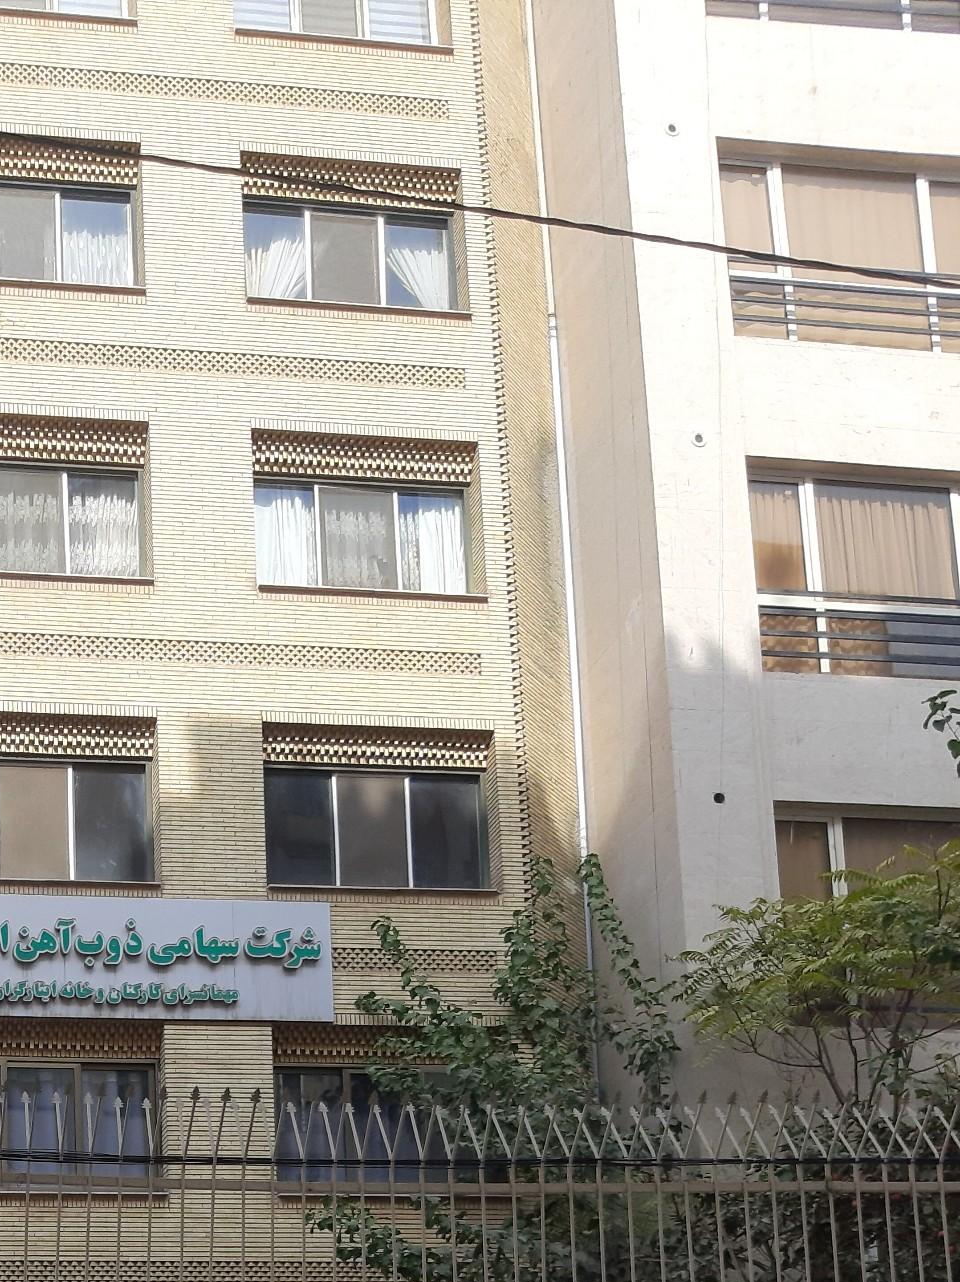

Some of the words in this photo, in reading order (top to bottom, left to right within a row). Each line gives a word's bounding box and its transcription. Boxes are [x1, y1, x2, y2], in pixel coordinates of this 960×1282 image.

[13, 918, 77, 963] آهن
[74, 918, 143, 968] ذوب
[147, 925, 240, 965] سهامی
[245, 926, 322, 969] شرکت
[59, 980, 95, 1000] خانه
[93, 987, 105, 1004] و
[106, 982, 163, 1005] کارکنان
[162, 982, 240, 1006] مهمانسرای
